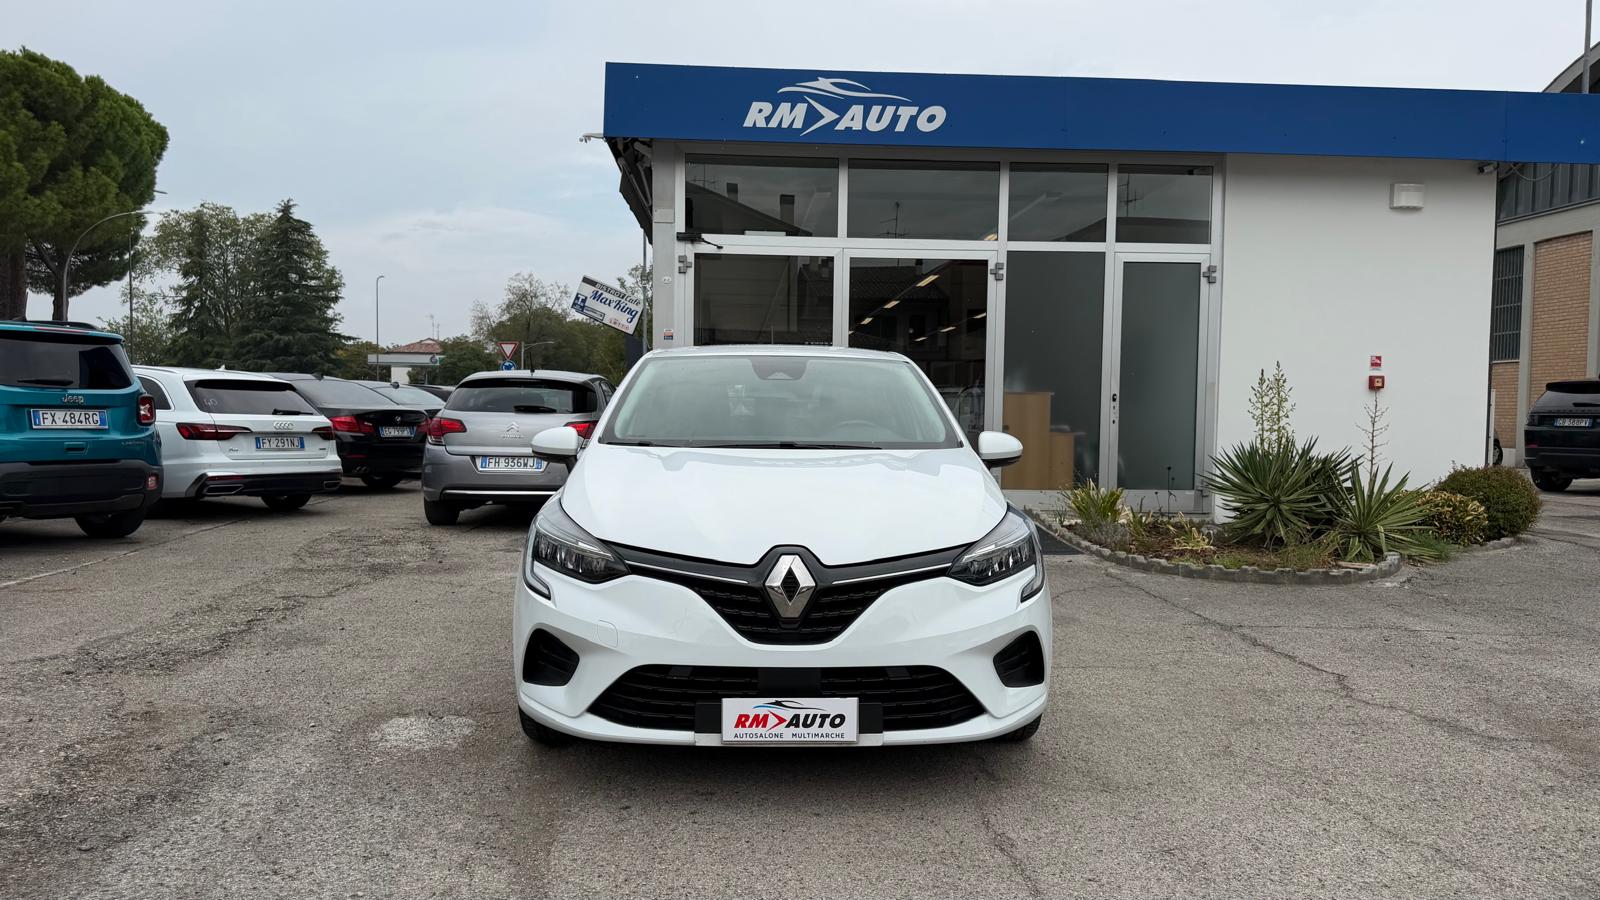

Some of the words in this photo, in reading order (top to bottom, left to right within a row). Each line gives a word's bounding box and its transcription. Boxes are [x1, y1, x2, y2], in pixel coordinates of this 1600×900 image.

[743, 101, 808, 129] RM
[834, 104, 947, 132] AUTO
[41, 412, 57, 425] FX
[62, 412, 99, 425] 484RG
[261, 438, 272, 448] FY
[275, 438, 300, 448] 291NJ
[487, 457, 500, 468] FH
[504, 457, 535, 468] 936WJ
[734, 713, 770, 728] RM
[785, 713, 846, 728] AUTO
